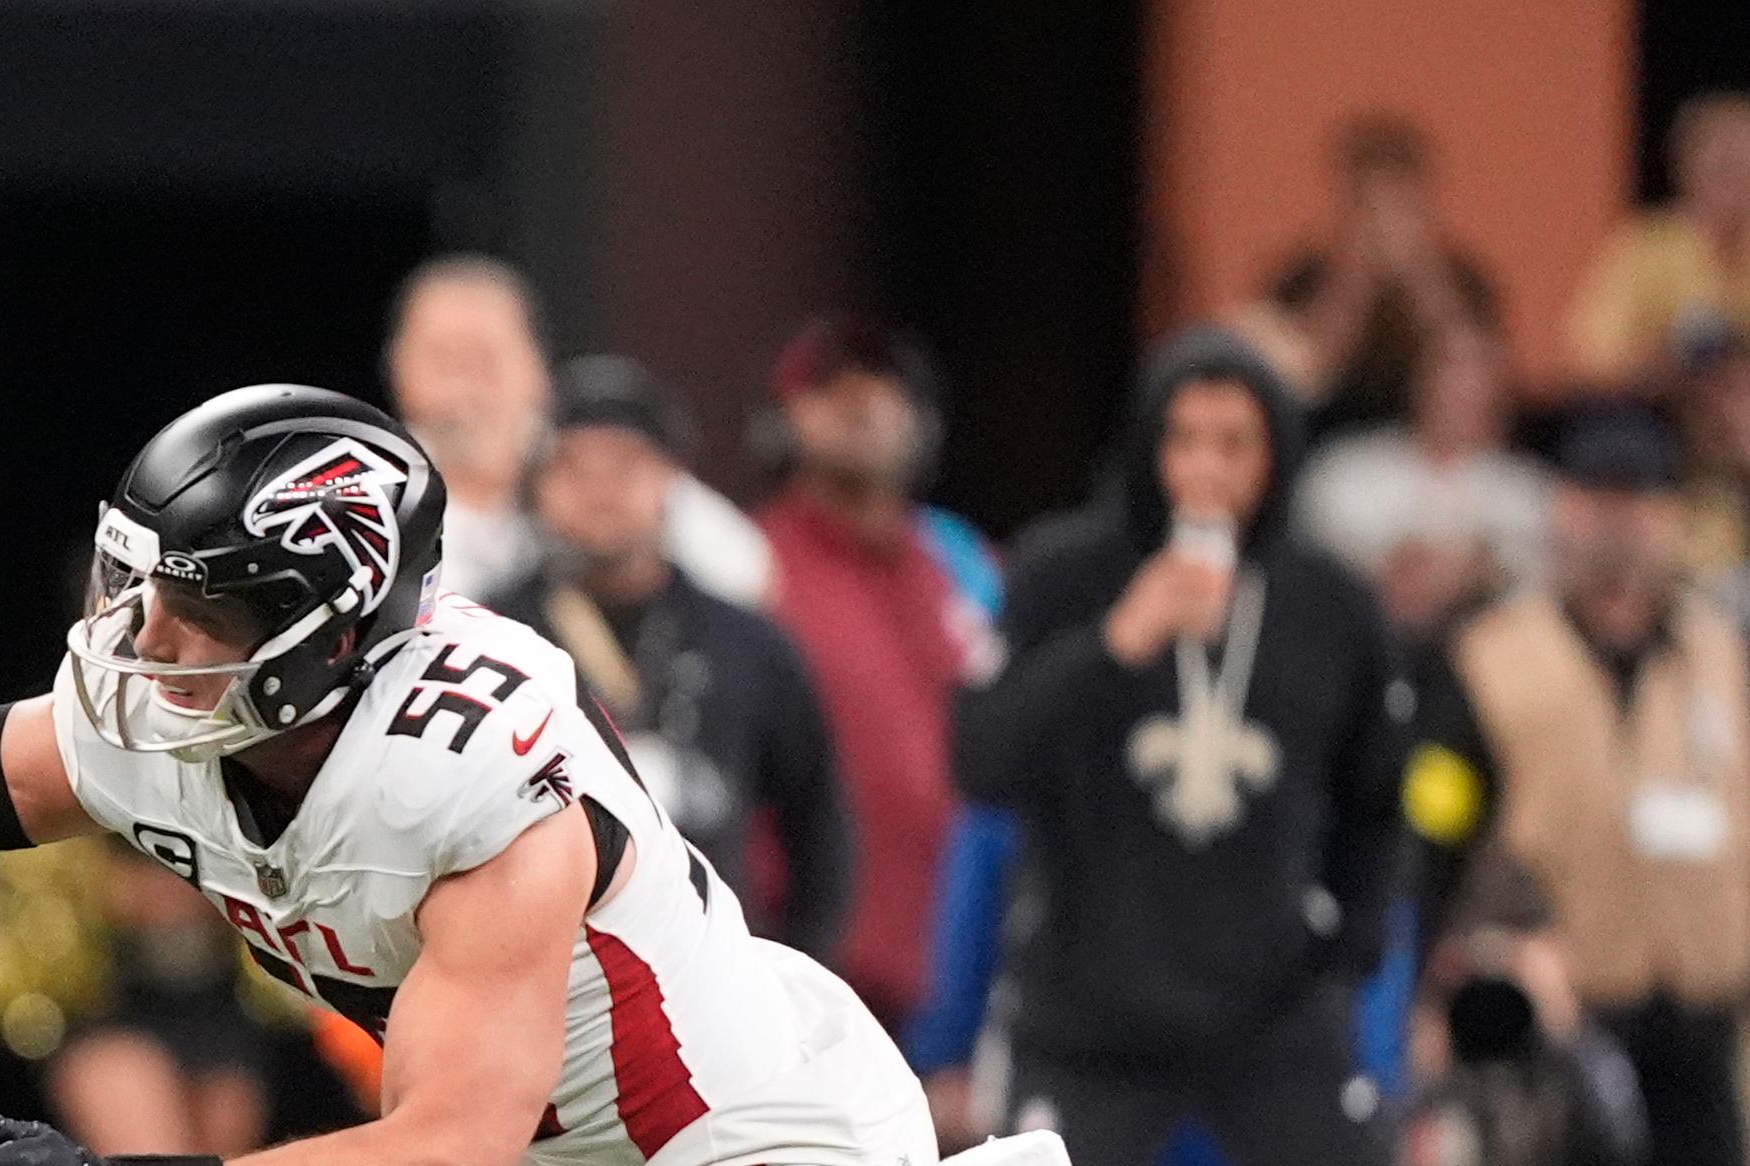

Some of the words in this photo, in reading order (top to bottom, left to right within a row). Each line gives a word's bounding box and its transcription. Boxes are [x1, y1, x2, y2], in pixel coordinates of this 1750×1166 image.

[106, 525, 131, 551] ATL
[385, 643, 533, 755] 55
[223, 894, 377, 978] ATL
